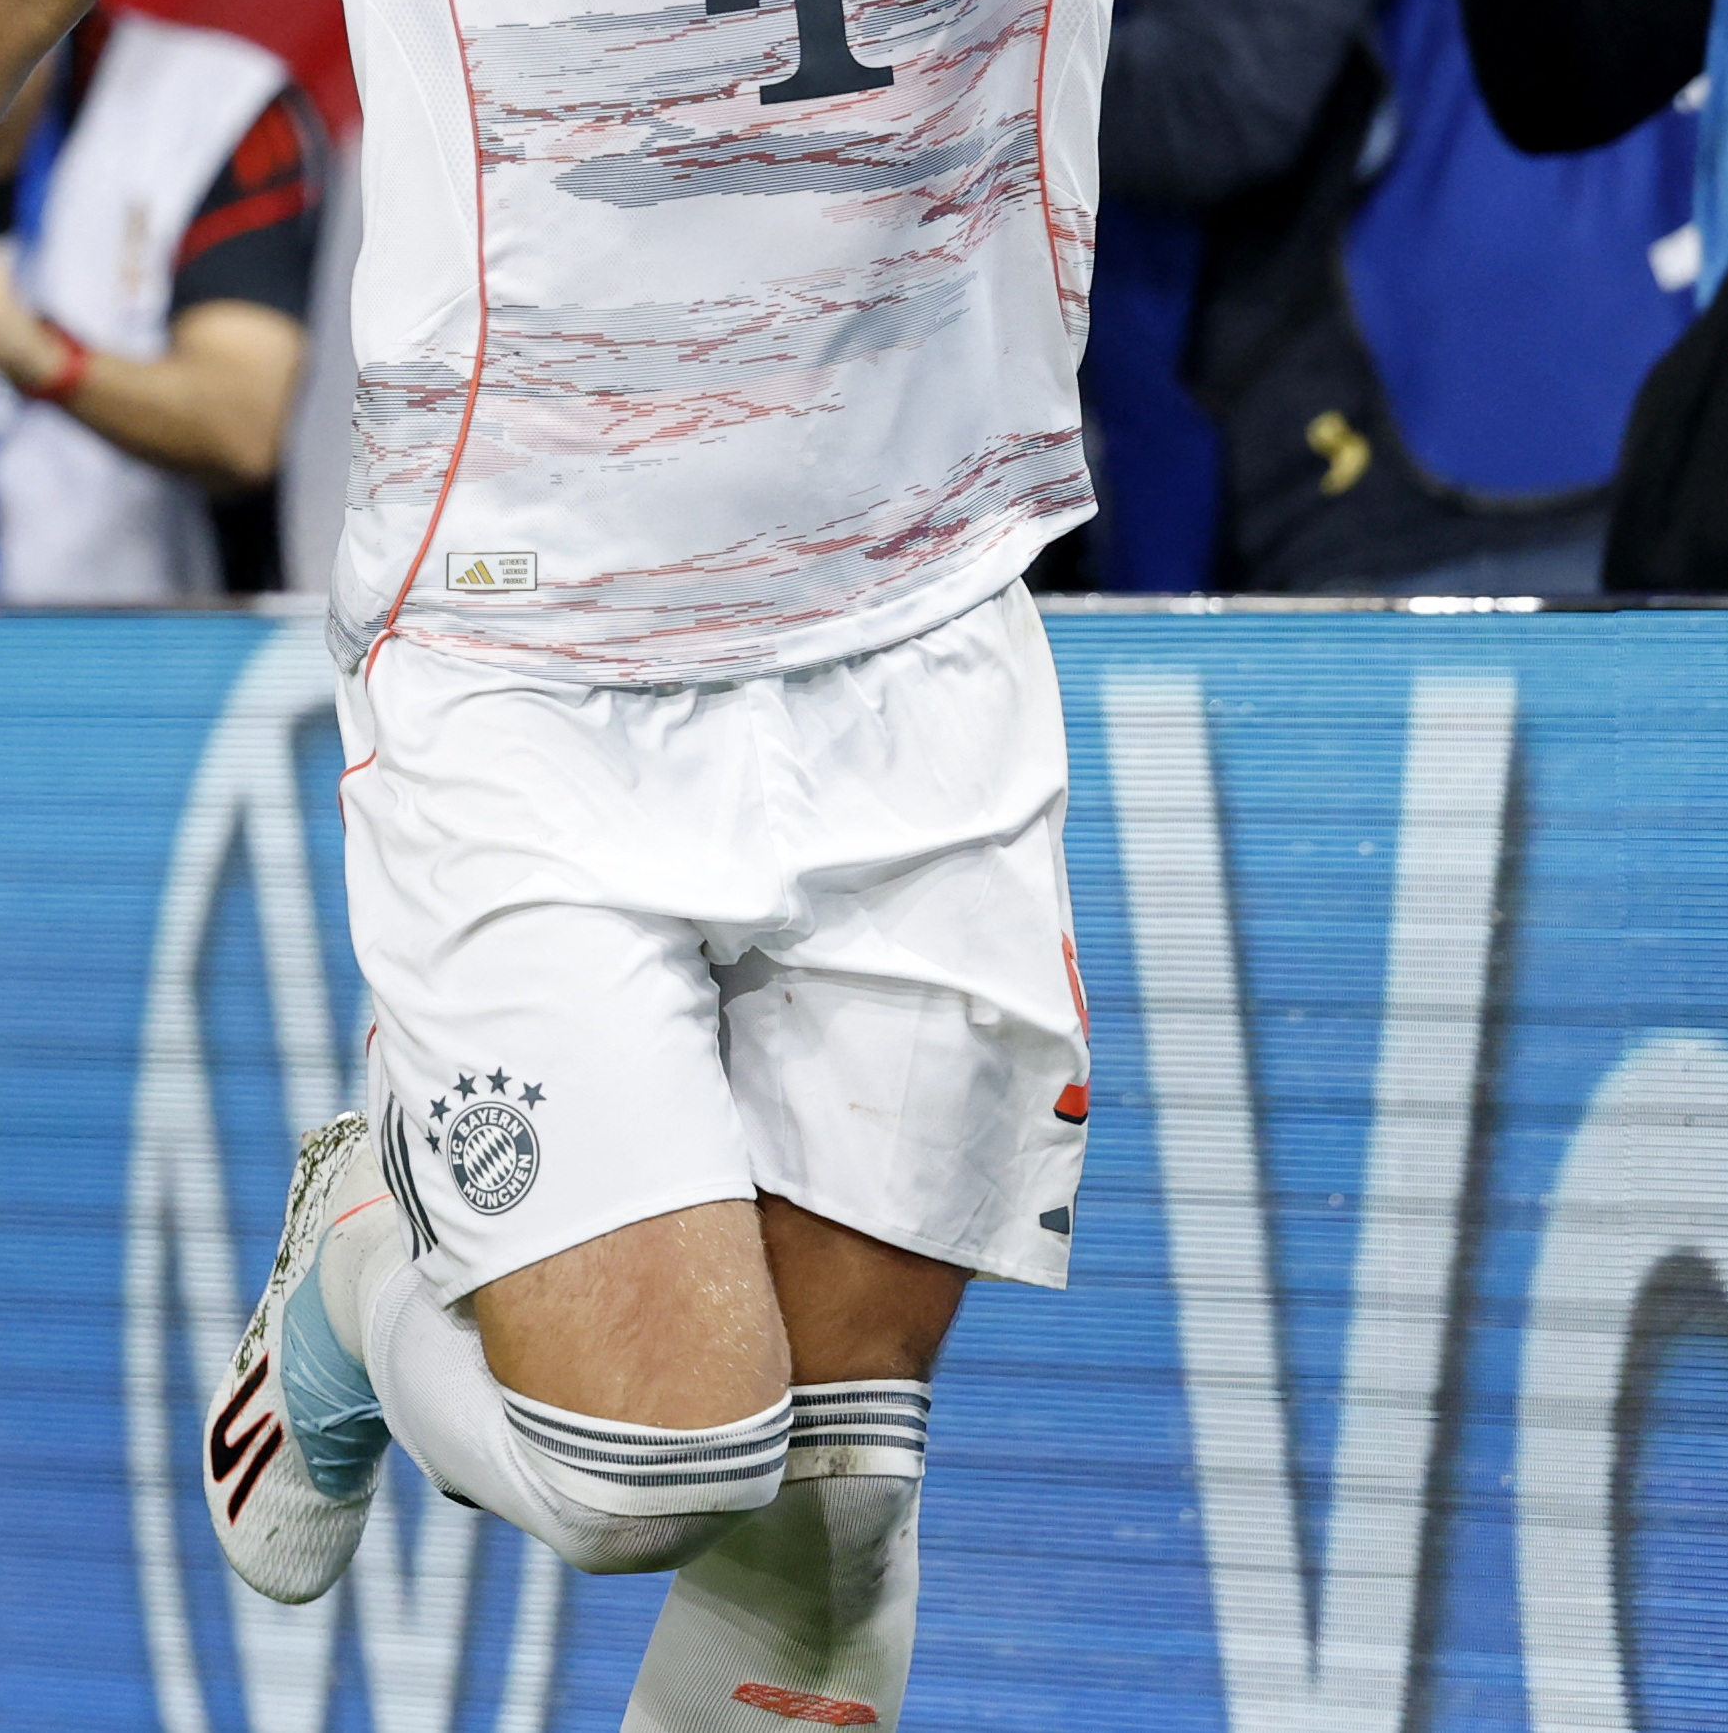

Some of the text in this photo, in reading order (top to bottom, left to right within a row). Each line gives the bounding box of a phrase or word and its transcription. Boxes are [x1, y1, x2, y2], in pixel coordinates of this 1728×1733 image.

[452, 1108, 524, 1165] FC BAYERN
[463, 1154, 532, 1208] MÜNCHEN
